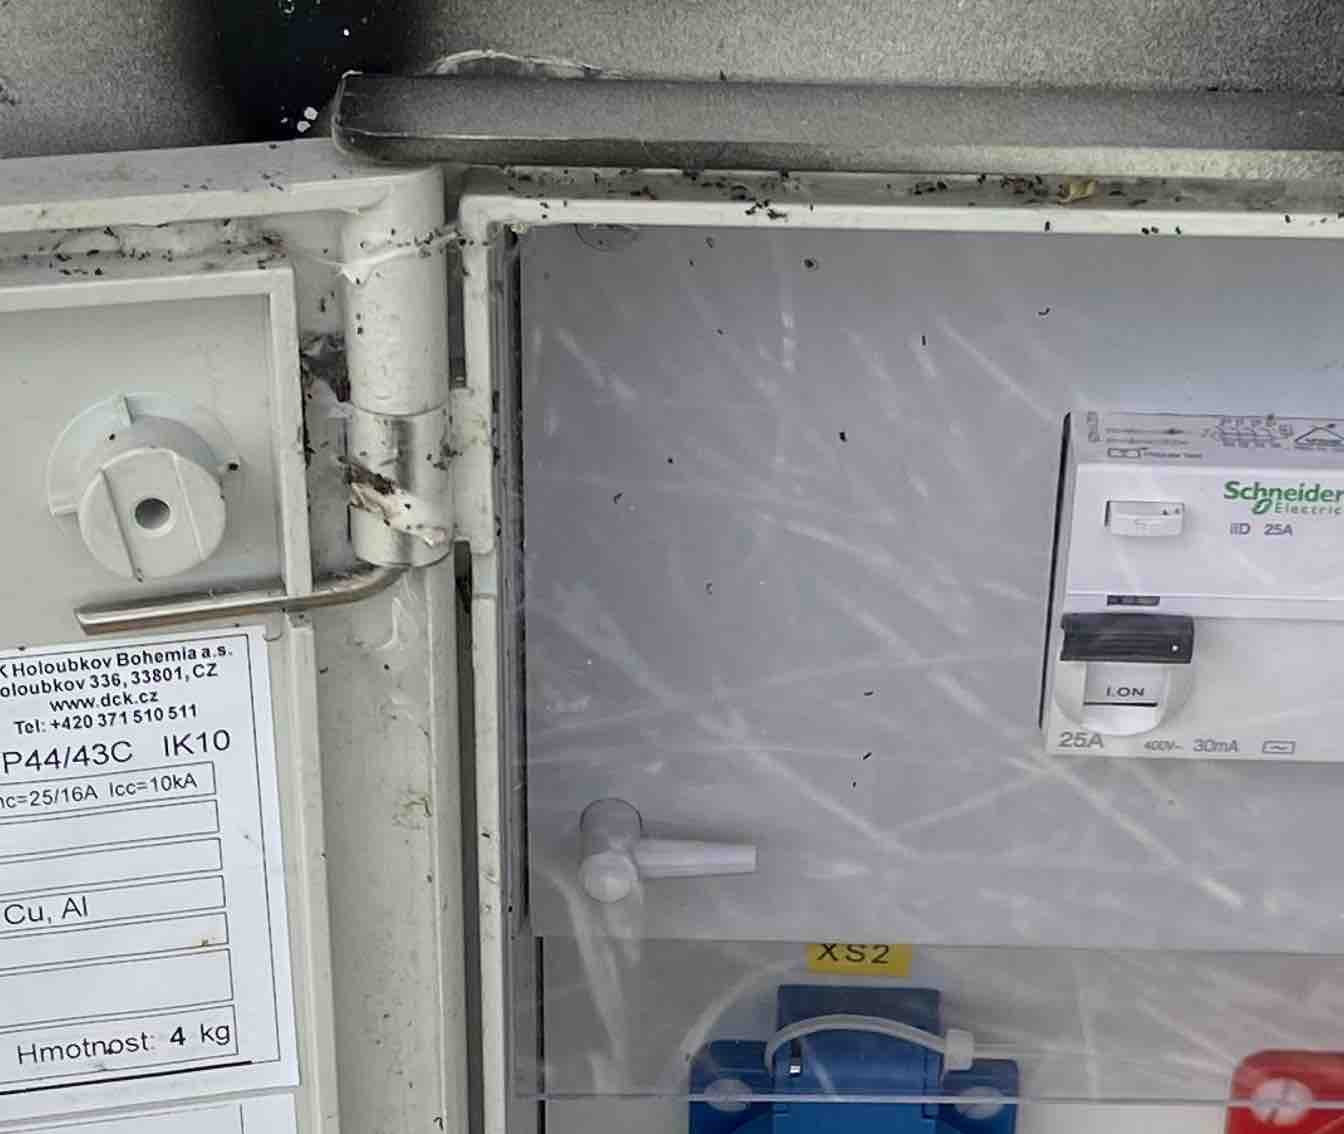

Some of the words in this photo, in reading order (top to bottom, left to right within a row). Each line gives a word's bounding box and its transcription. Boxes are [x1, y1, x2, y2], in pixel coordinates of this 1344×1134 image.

[1274, 502, 1343, 516] Electric
[1264, 523, 1293, 536] 25A
[12, 655, 112, 679] Holoubkov
[117, 646, 197, 668] Bohemia
[201, 645, 233, 660] a.s.
[90, 672, 127, 691] 336,
[131, 666, 189, 685] 33801,
[193, 662, 218, 679] CZ
[50, 690, 159, 713] www.dck.cz
[14, 717, 46, 735] Tel:
[50, 714, 93, 731] +420
[97, 711, 128, 727] 371
[133, 707, 164, 724] 510
[168, 703, 198, 720] 511
[162, 729, 232, 757] IK10
[1058, 731, 1105, 749] 25A
[1192, 738, 1240, 753] 30mA
[109, 772, 198, 797] Icc=10kA
[3, 902, 53, 926] Cu,
[62, 895, 89, 921] Al
[816, 943, 890, 964] XS2
[17, 1032, 155, 1066] Hmotnost:
[169, 1025, 186, 1047] 4
[199, 1022, 232, 1049] kg
